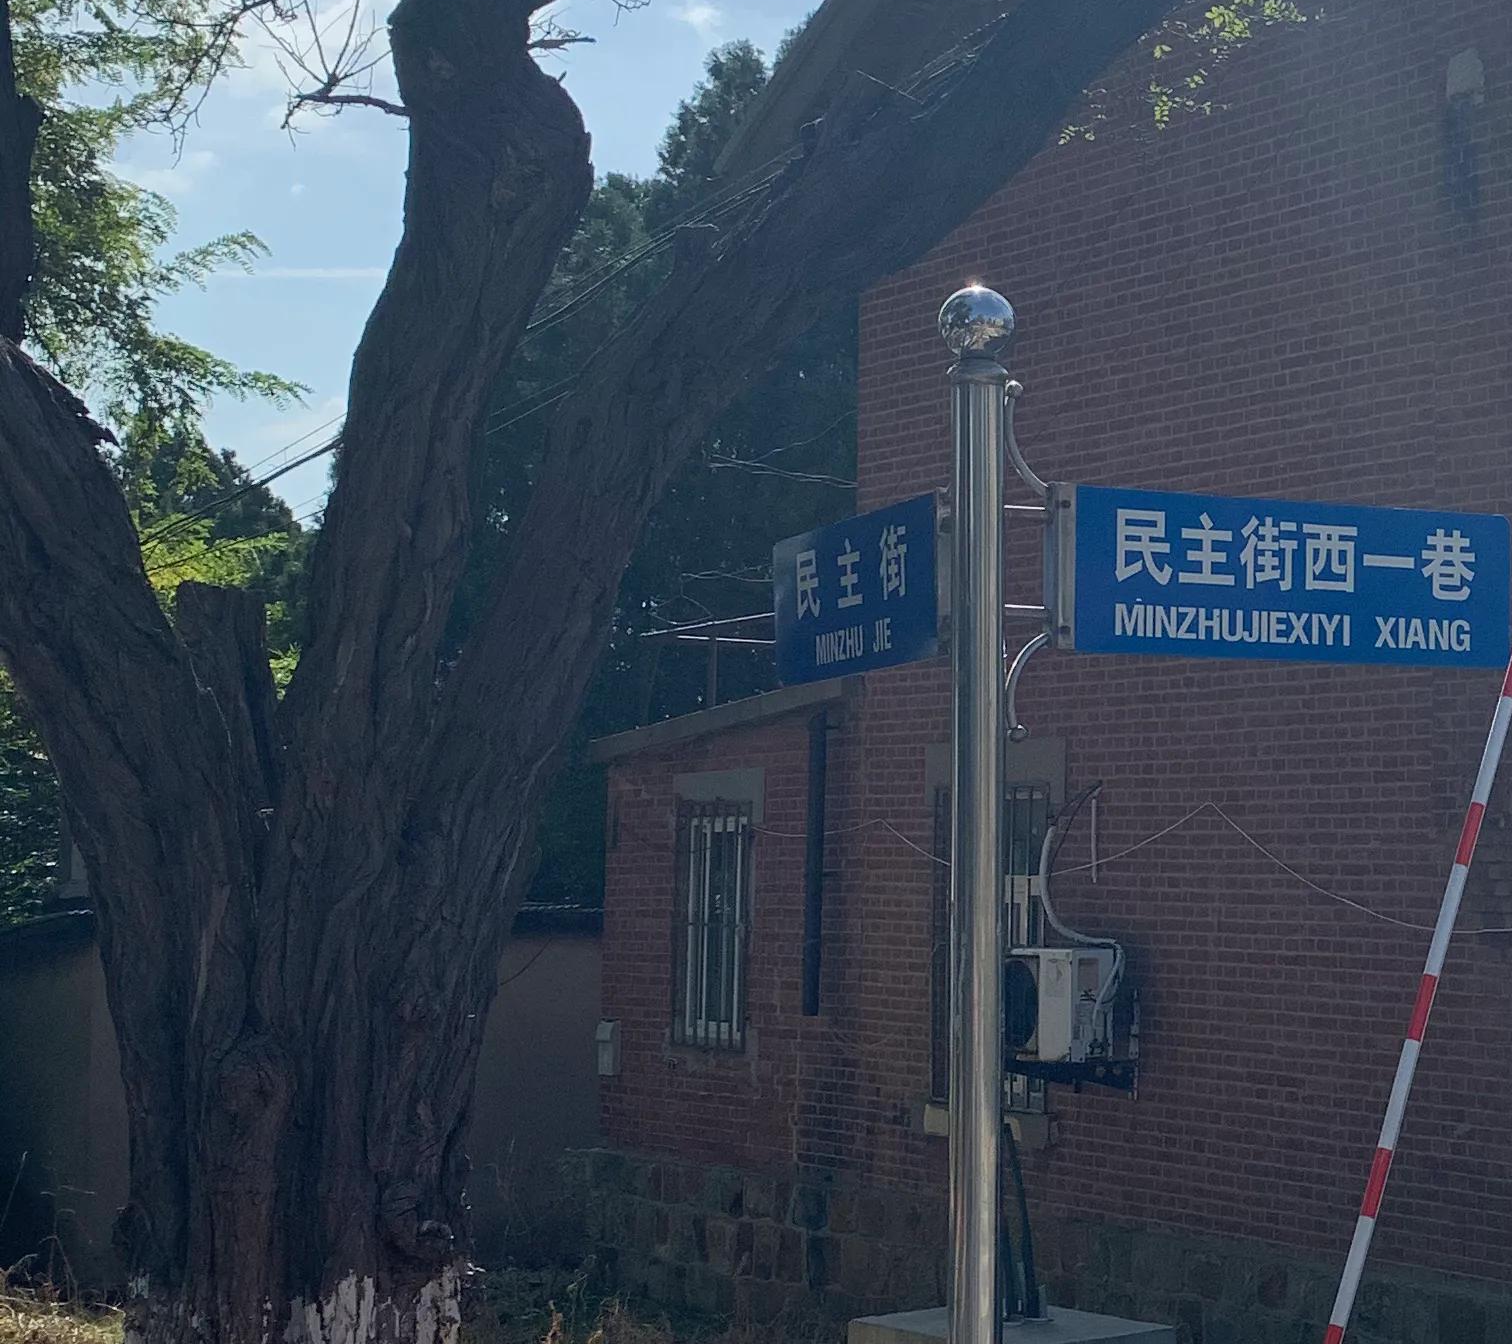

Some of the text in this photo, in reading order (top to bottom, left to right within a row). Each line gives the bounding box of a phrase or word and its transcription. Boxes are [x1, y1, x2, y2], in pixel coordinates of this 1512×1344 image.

[796, 524, 908, 621] 民主街
[1115, 508, 1476, 602] 民主街西一巷
[815, 617, 893, 666] MINZHU JIE
[1114, 602, 1472, 652] MINZHUJIEXIYI XIANG
